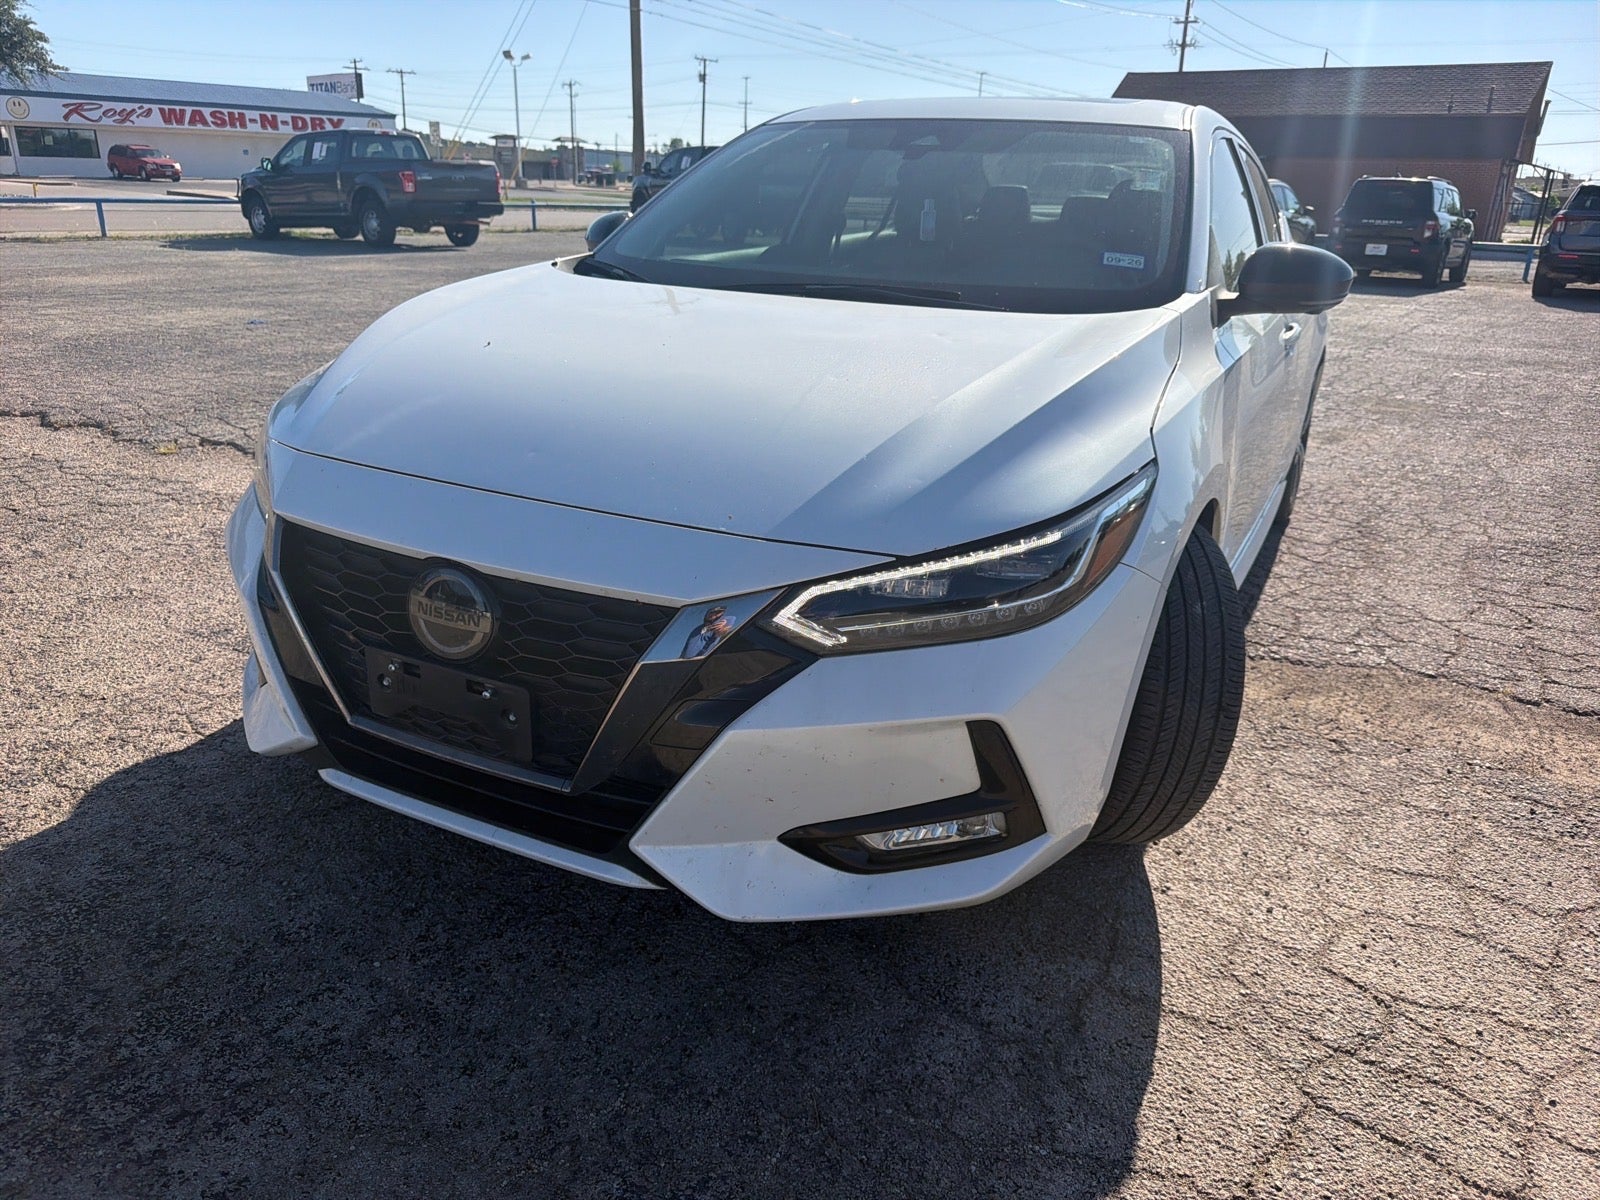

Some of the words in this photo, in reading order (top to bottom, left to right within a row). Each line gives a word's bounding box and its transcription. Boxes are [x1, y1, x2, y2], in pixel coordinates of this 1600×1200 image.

[62, 102, 153, 125] Roy's
[158, 107, 345, 132] WASH-N-DRY
[417, 600, 481, 627] NISSAN
